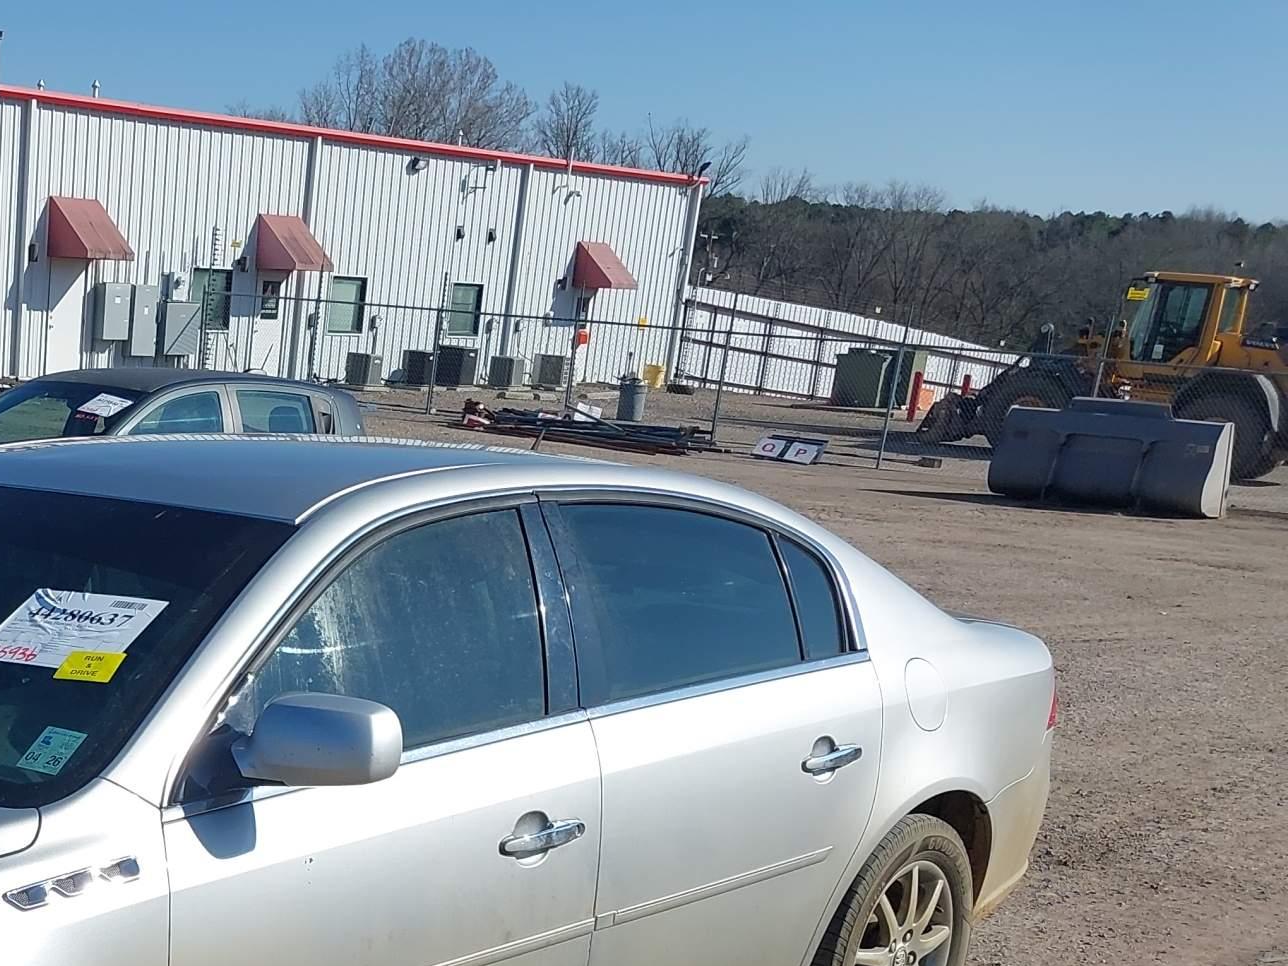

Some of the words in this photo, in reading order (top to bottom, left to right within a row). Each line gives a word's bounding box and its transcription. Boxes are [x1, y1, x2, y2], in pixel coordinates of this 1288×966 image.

[761, 443, 776, 453] Q
[794, 448, 808, 457] P
[28, 606, 135, 628] 44280637
[70, 669, 99, 677] DRIVE
[25, 751, 42, 762] 04
[46, 755, 63, 767] 26
